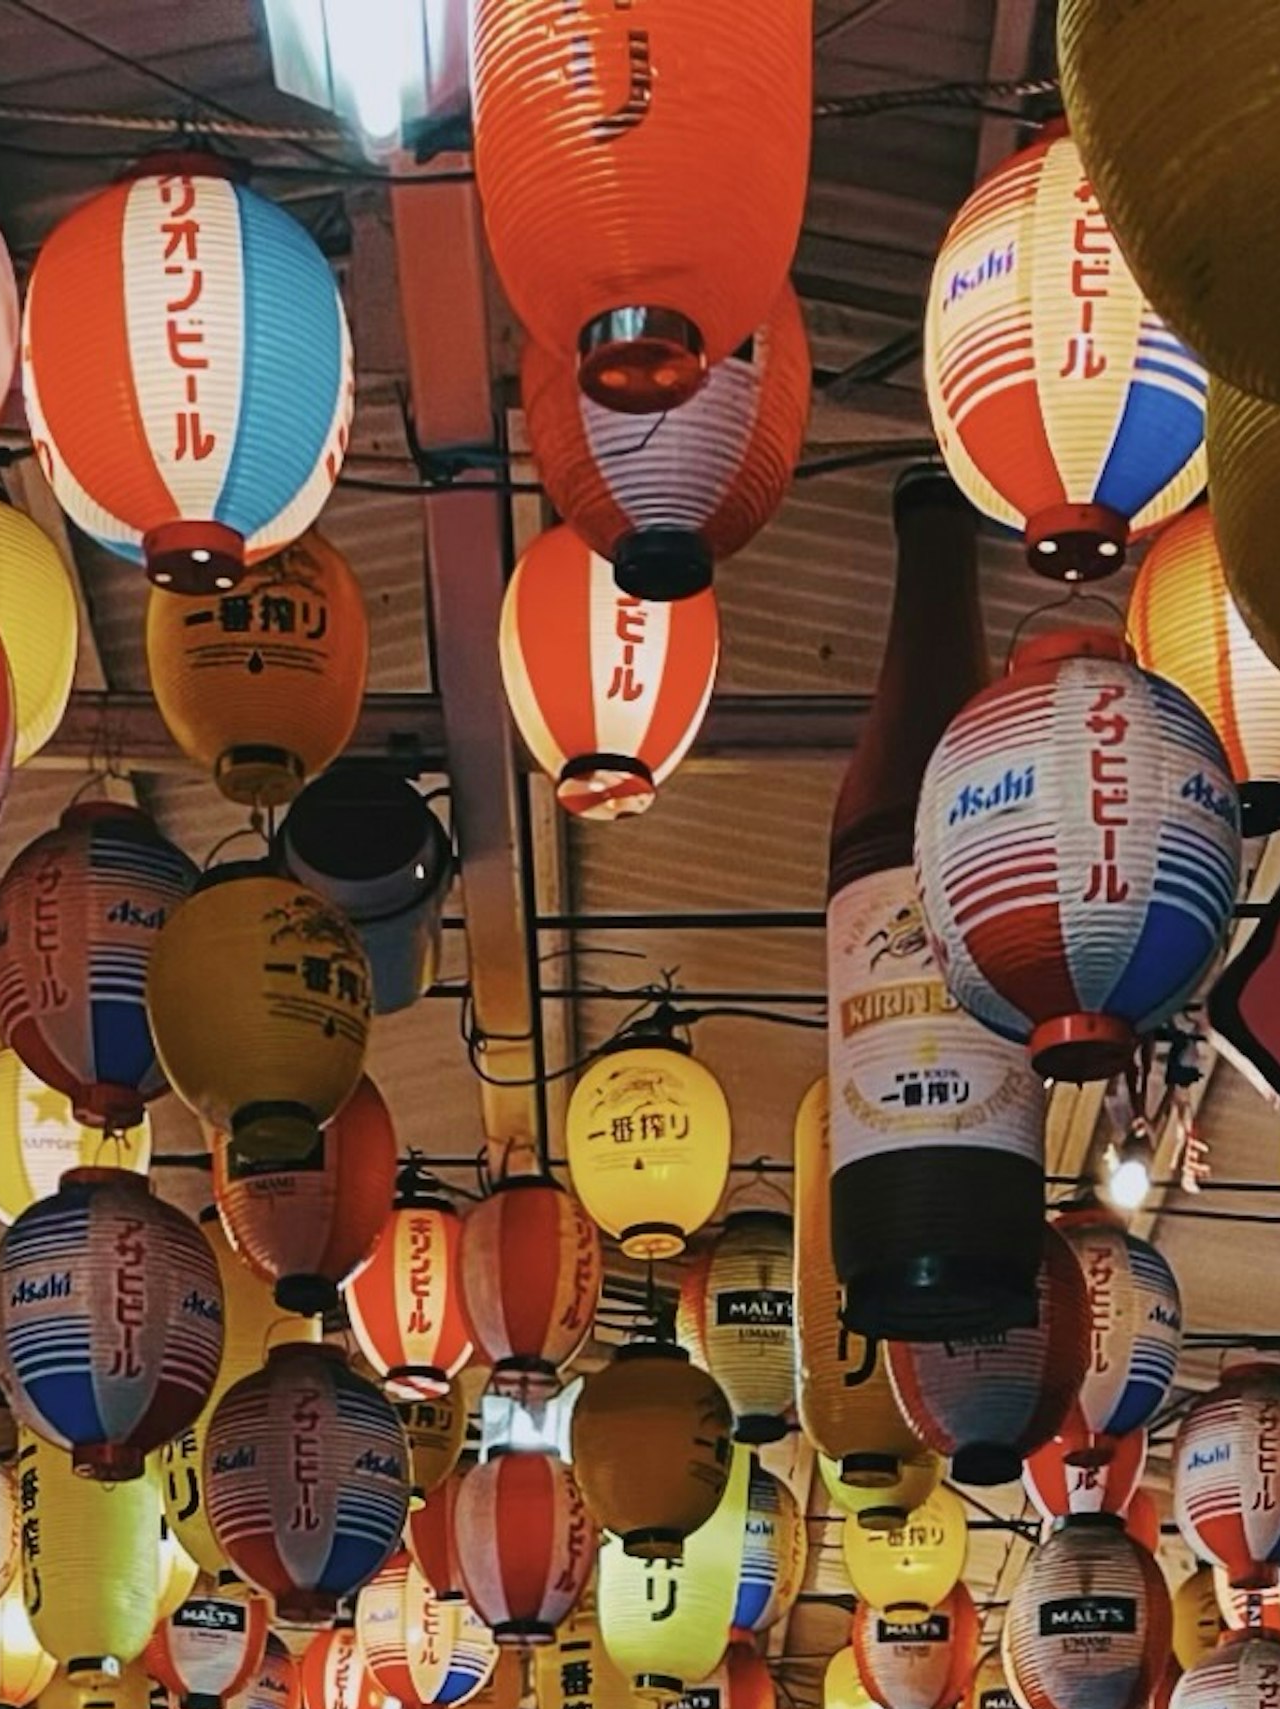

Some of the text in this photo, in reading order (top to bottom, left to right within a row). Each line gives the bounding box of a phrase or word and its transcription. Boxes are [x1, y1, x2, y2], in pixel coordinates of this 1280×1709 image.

[157, 175, 215, 461] リオンビール
[183, 594, 328, 638] 一番搾り
[949, 766, 1036, 826] Asahi
[1084, 684, 1129, 904] アサヒビール
[587, 1114, 691, 1145] 一番搾り
[12, 1273, 71, 1308] Asahi
[110, 1218, 146, 1380] アサヒビール
[291, 1390, 319, 1532] アサヒビール
[867, 1528, 945, 1548] 一番搾り
